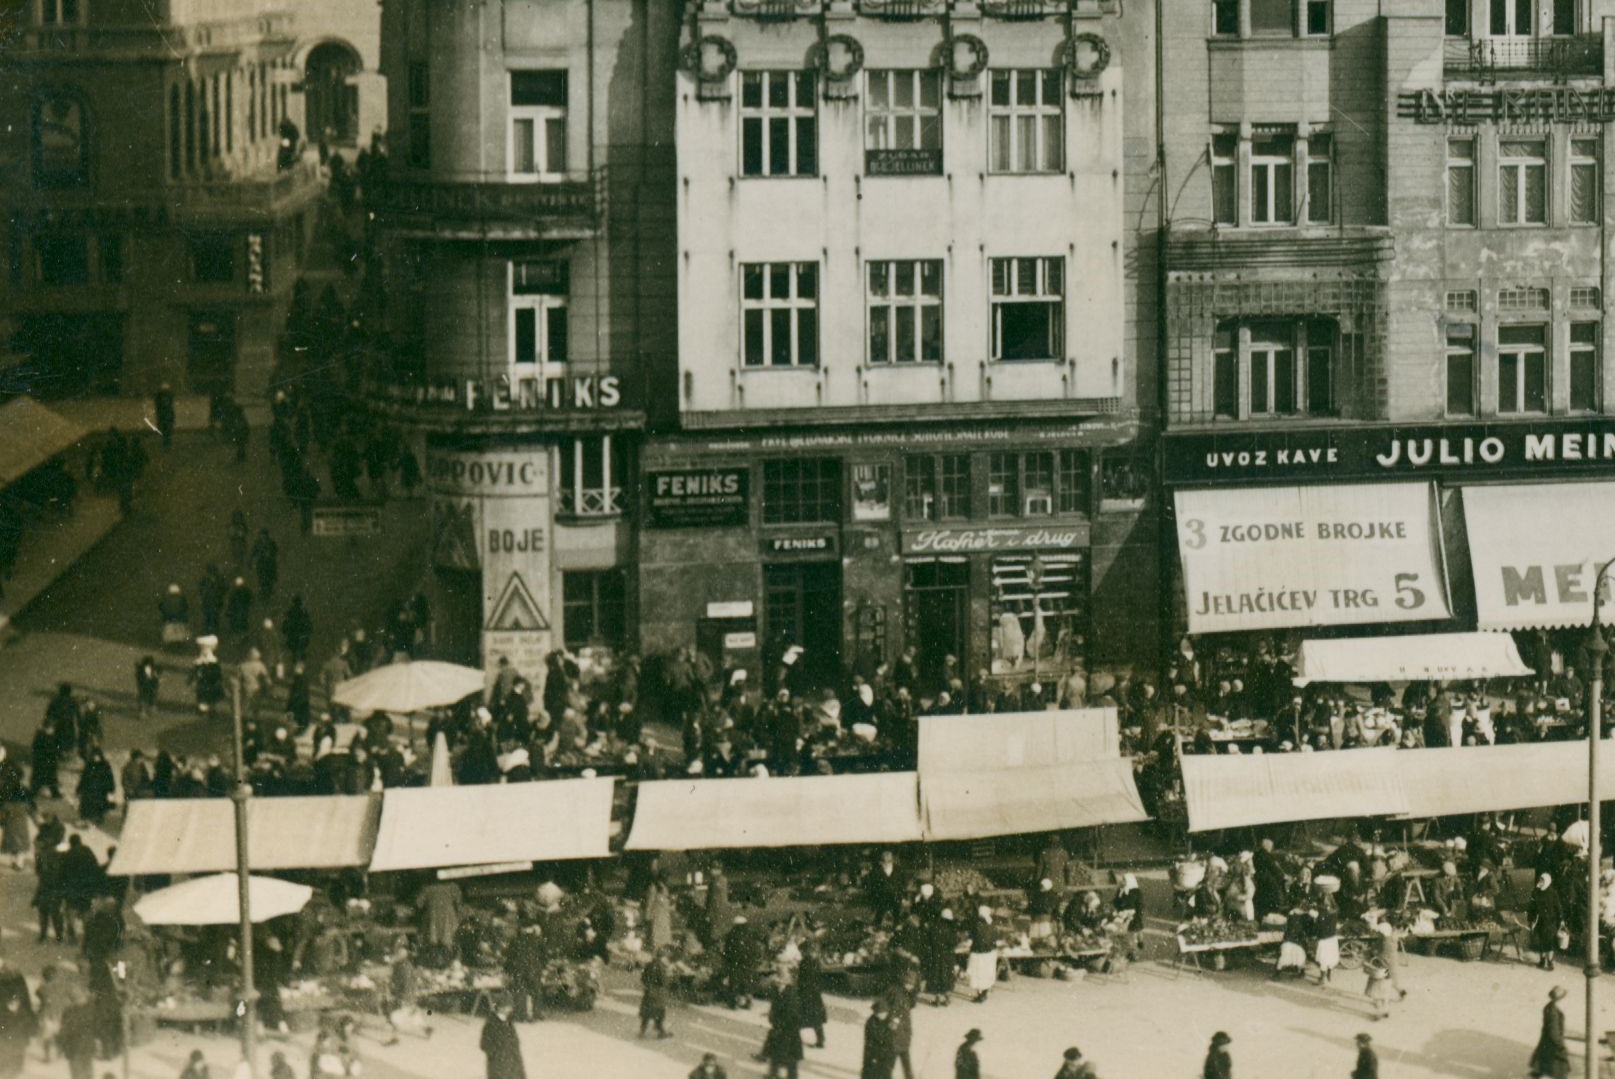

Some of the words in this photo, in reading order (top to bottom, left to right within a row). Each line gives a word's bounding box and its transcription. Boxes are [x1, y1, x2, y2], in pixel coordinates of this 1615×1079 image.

[466, 376, 621, 411] FENIKS
[1207, 451, 1268, 467] UVOZ
[1277, 448, 1338, 464] KAVE
[1376, 437, 1506, 467] JULIO
[656, 474, 739, 496] FENIKS
[488, 528, 545, 553] BOJE
[773, 538, 827, 555] FENIKS
[1022, 528, 1077, 550] drug
[1185, 517, 1208, 551] 3
[1219, 521, 1305, 543] ZGODNE
[1317, 521, 1408, 540] BROJKE
[1195, 584, 1318, 616] JELAČIĆEV
[1328, 588, 1380, 609] TRG
[1394, 572, 1427, 611] 5
